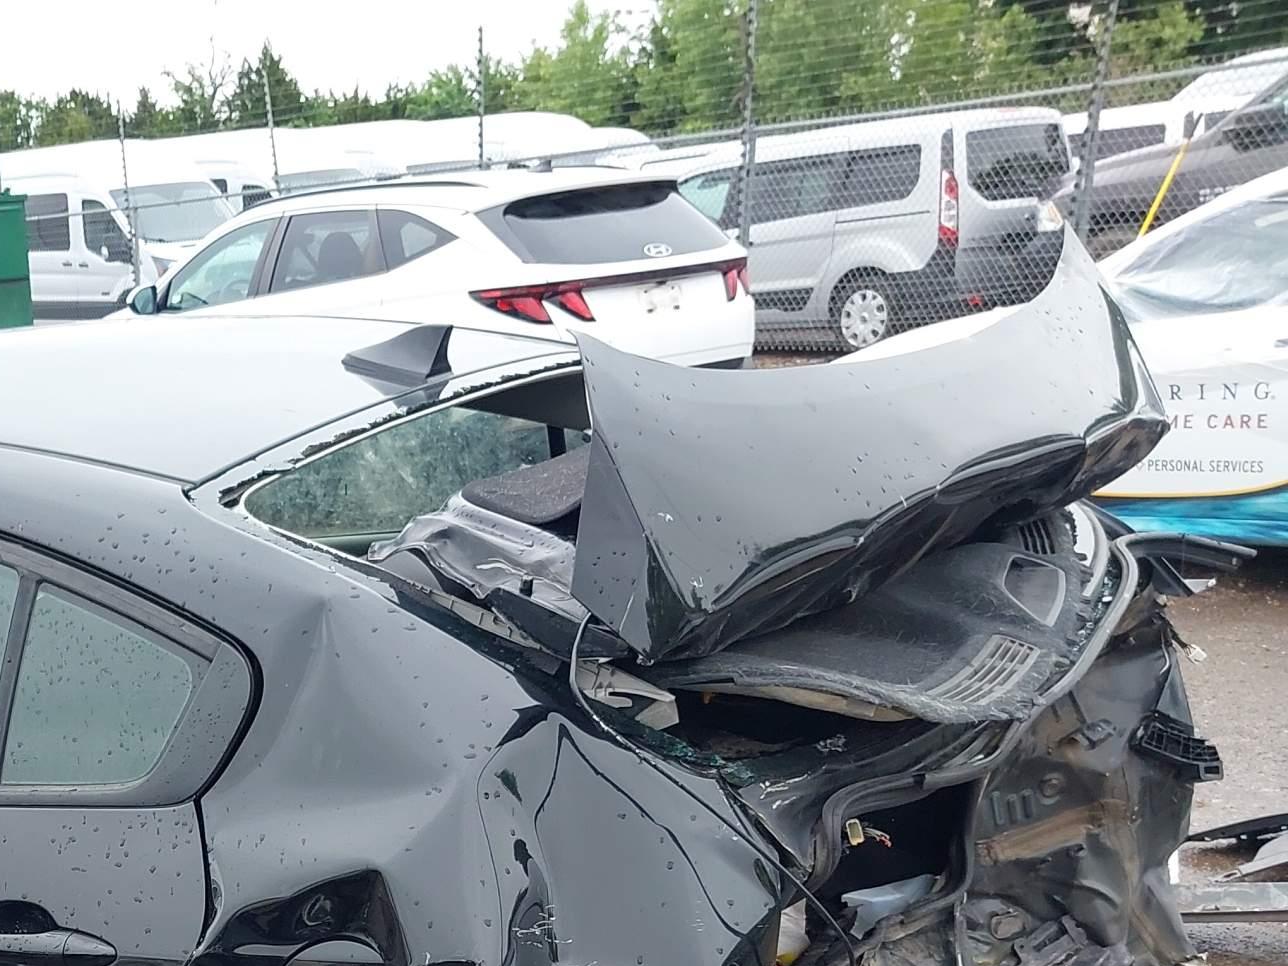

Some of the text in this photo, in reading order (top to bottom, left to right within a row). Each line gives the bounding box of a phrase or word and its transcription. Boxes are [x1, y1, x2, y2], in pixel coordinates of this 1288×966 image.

[1207, 414, 1268, 429] CARE
[1147, 459, 1264, 473] PERSONAL SERVICES
